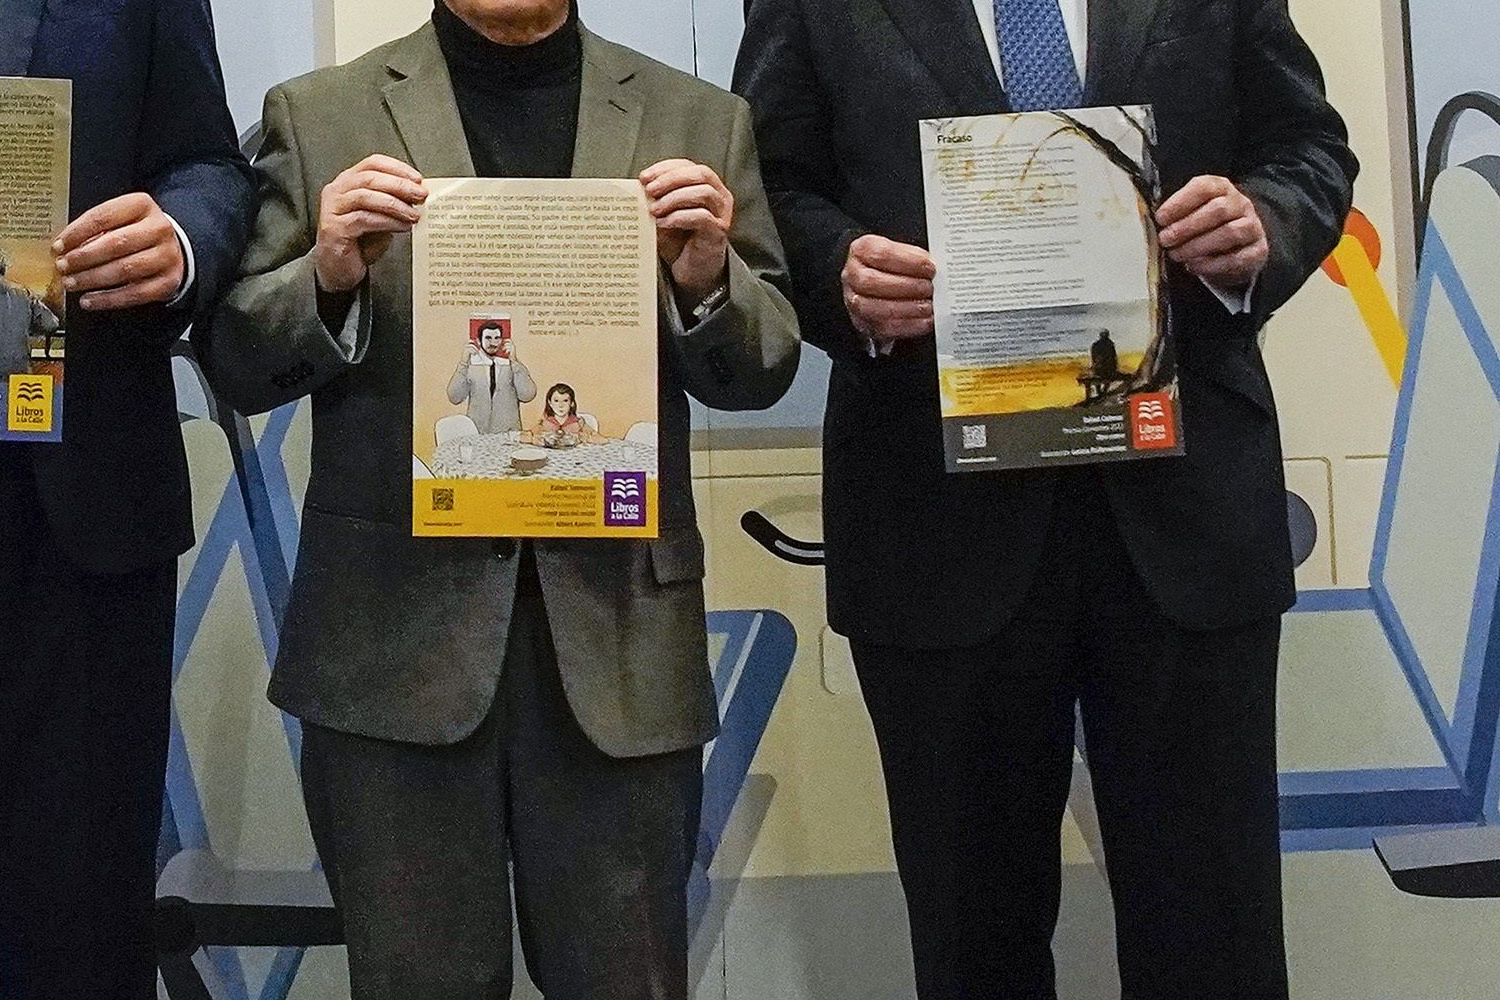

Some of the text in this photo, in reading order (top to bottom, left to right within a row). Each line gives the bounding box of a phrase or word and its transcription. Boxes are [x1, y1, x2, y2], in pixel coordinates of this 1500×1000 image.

[936, 134, 973, 144] Fracaso
[16, 407, 44, 417] Libros
[611, 502, 639, 512] Libros
